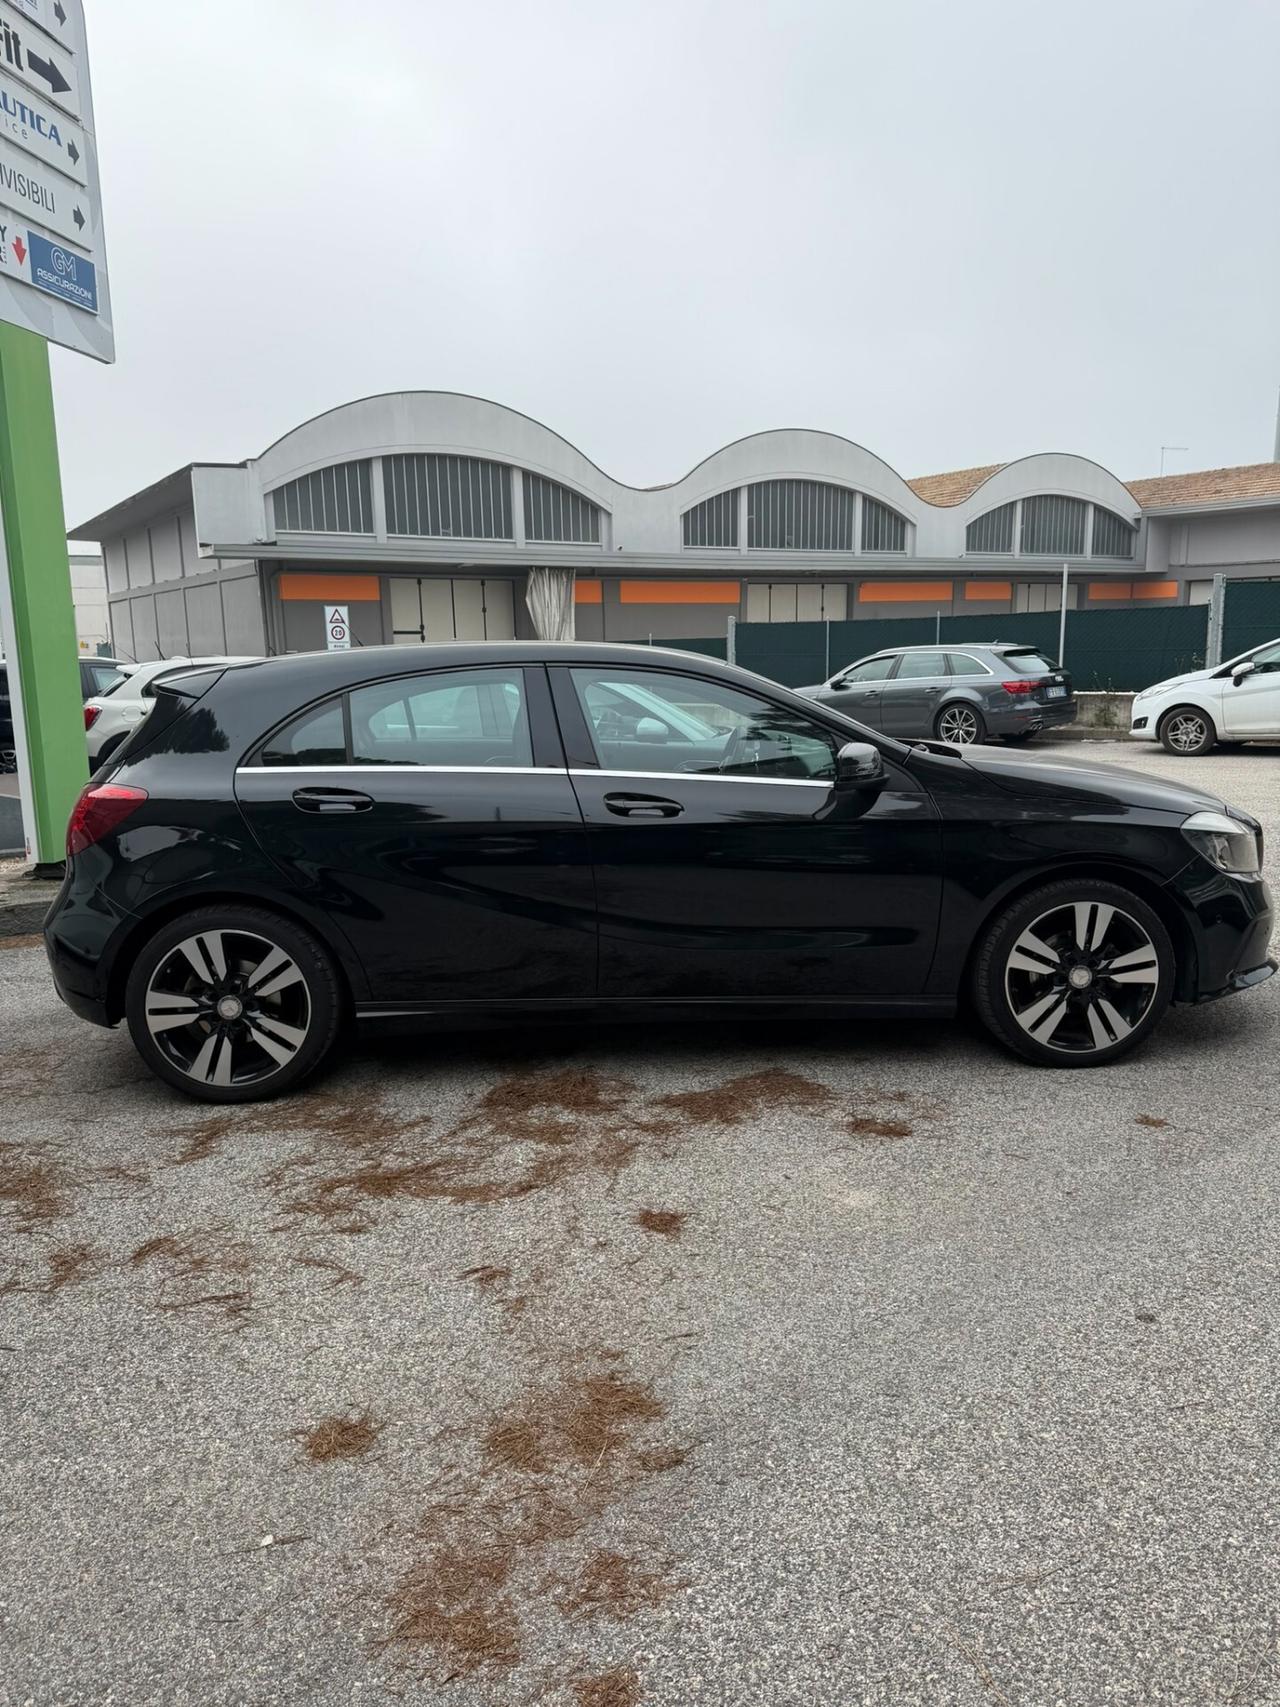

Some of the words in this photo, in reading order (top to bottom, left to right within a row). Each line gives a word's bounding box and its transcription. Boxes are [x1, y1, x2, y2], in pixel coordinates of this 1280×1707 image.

[0, 18, 24, 72] it
[0, 90, 62, 147] UTICA
[51, 246, 77, 281] GM
